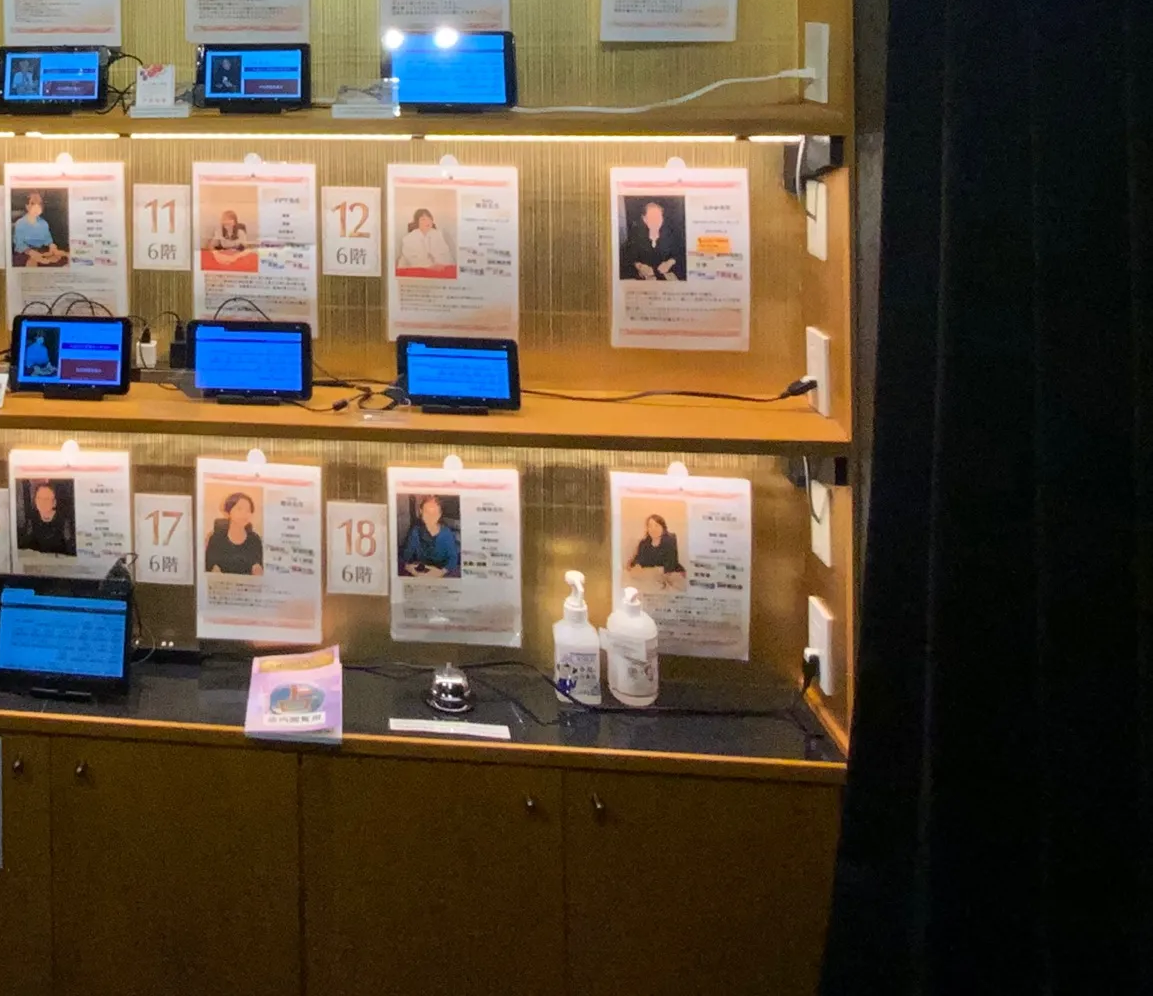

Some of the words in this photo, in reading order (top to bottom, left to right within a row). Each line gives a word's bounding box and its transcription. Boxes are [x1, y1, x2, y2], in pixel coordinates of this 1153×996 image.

[145, 198, 177, 234] 11
[332, 202, 370, 238] 12
[148, 243, 177, 261] 6階
[337, 246, 366, 265] 6階
[144, 510, 184, 546] 17
[337, 519, 377, 557] 18
[149, 554, 179, 573] 6階
[342, 565, 373, 584] 6階
